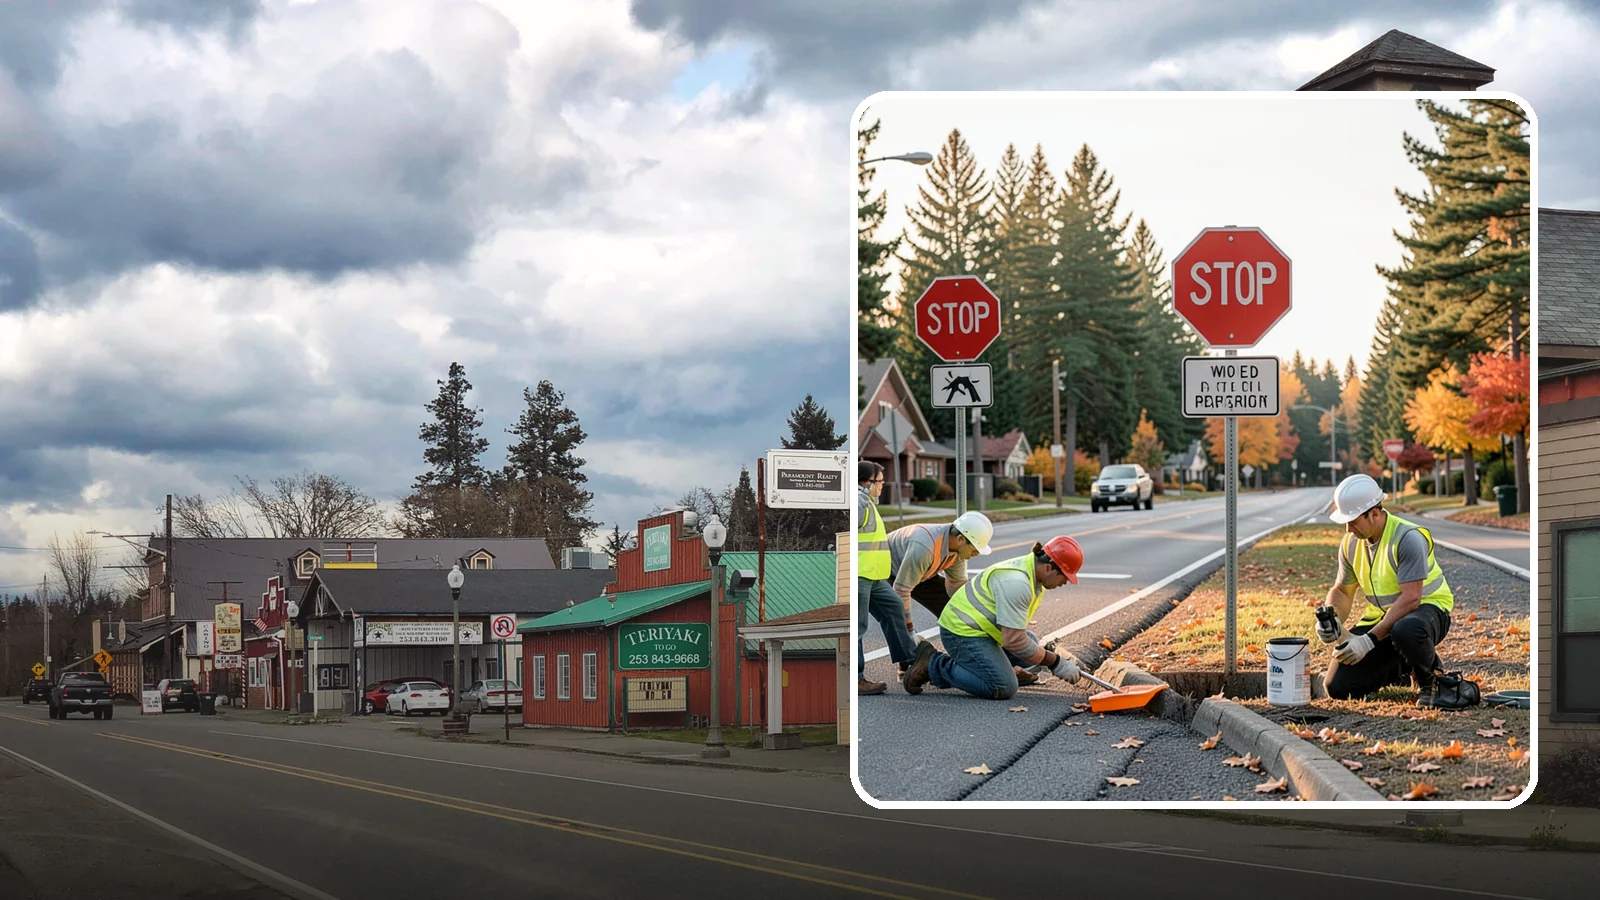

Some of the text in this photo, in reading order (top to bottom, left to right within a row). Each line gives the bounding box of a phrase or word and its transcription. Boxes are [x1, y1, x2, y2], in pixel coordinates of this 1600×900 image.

[1189, 261, 1277, 306] STOP
[927, 301, 990, 335] STOP
[781, 471, 839, 480] PARAMOUNT REALTY
[625, 627, 702, 646] TERIYAKI
[628, 653, 700, 665] 253 843-9668
